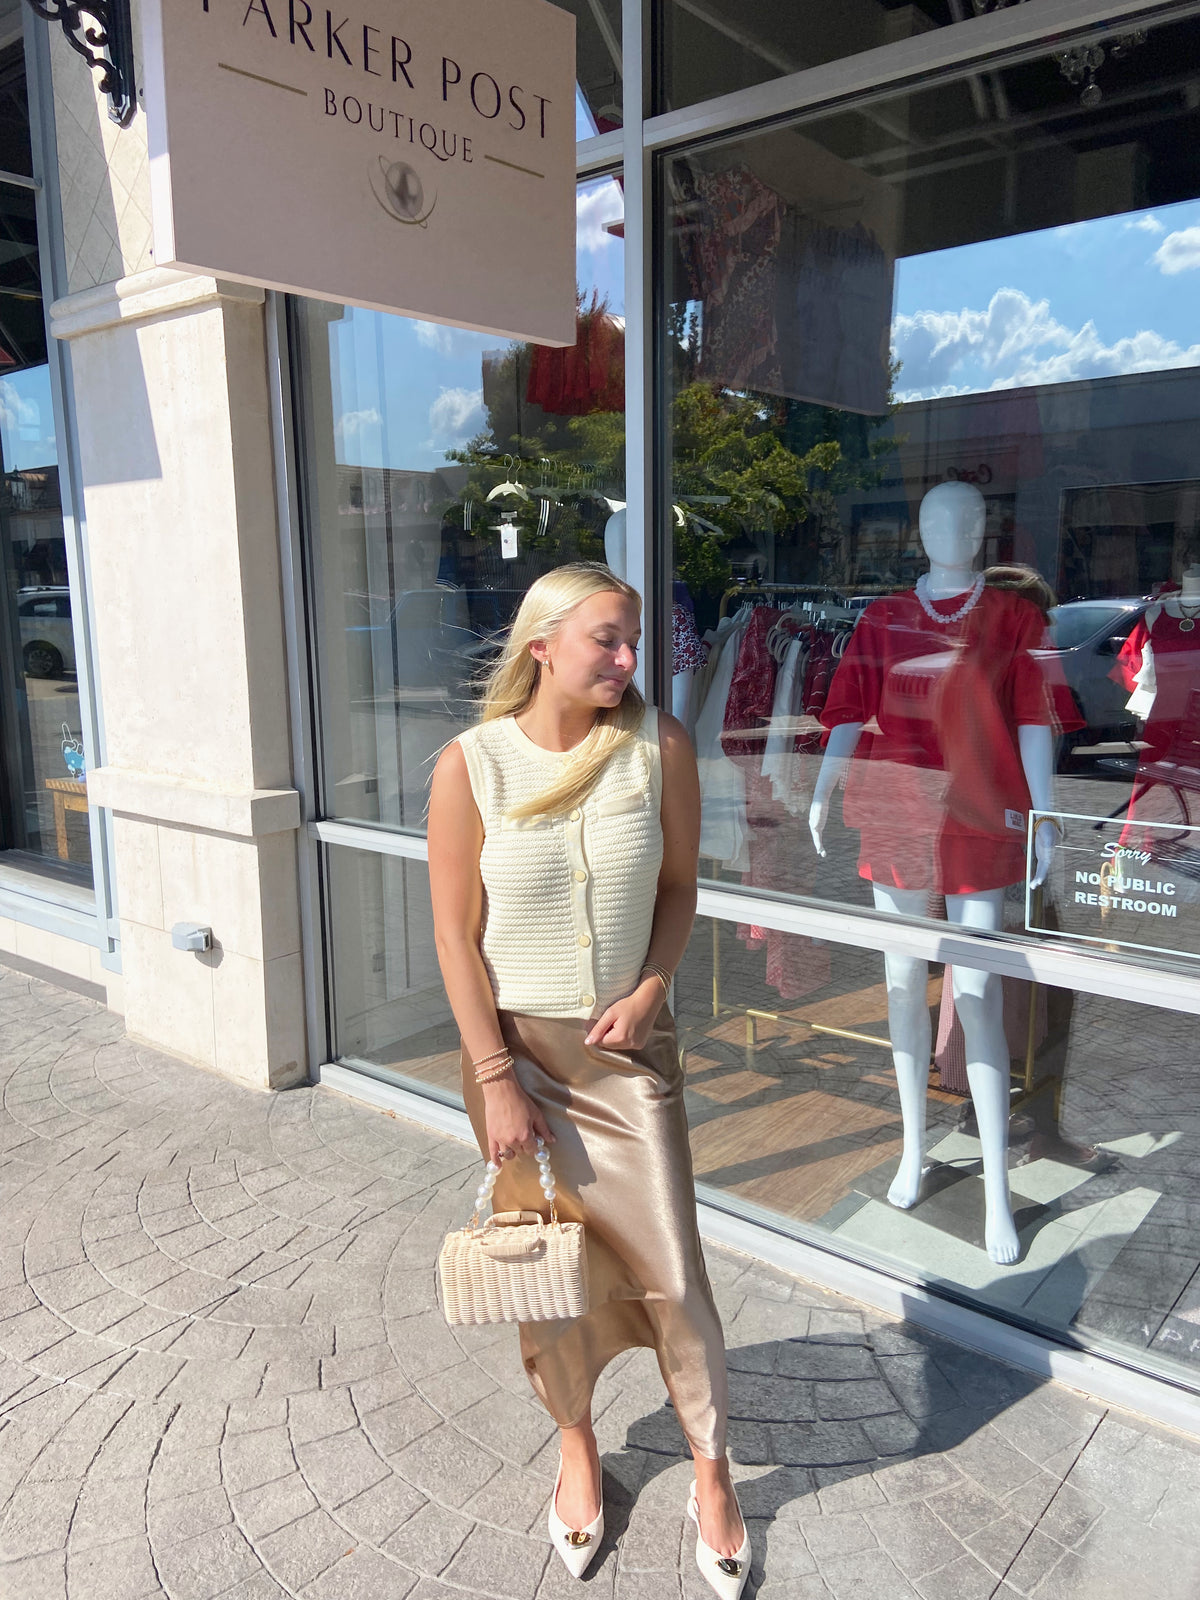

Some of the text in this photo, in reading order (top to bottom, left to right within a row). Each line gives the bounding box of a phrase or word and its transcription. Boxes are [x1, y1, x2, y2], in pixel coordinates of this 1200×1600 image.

[202, 0, 552, 138] ARKER POST
[324, 87, 473, 163] BOUTIQUE
[1100, 842, 1152, 866] Sorry
[1075, 871, 1176, 896] NO PUBLIC
[1074, 891, 1177, 918] RESTROOM
